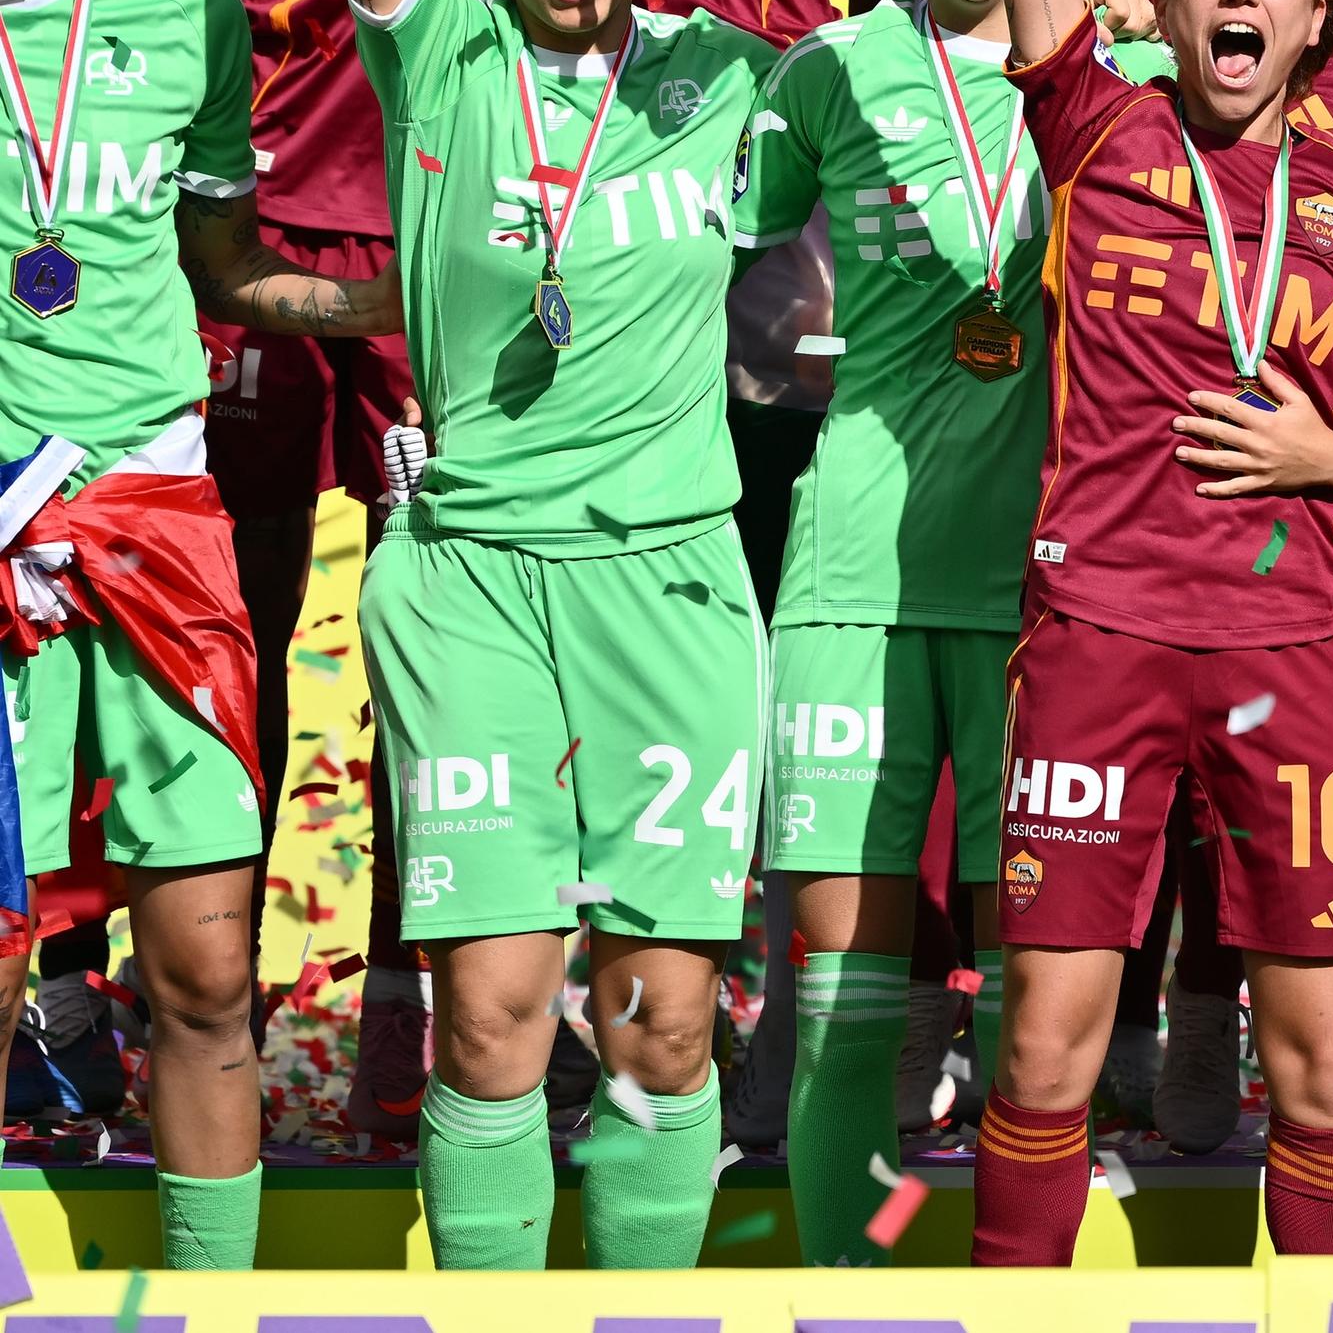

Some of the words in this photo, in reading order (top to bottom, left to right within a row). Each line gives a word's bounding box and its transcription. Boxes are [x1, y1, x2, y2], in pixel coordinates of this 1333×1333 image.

[944, 166, 1052, 249] TI
[1315, 235, 1332, 248] 1927
[206, 346, 262, 400] DI
[776, 702, 886, 760] HDI
[400, 753, 511, 813] HDI
[633, 743, 750, 851] 24
[1007, 757, 1126, 821] HDI
[405, 816, 514, 836] SSICURAZIONI
[1007, 822, 1121, 845] ASSICURAZIONI
[1008, 885, 1037, 896] ROMA
